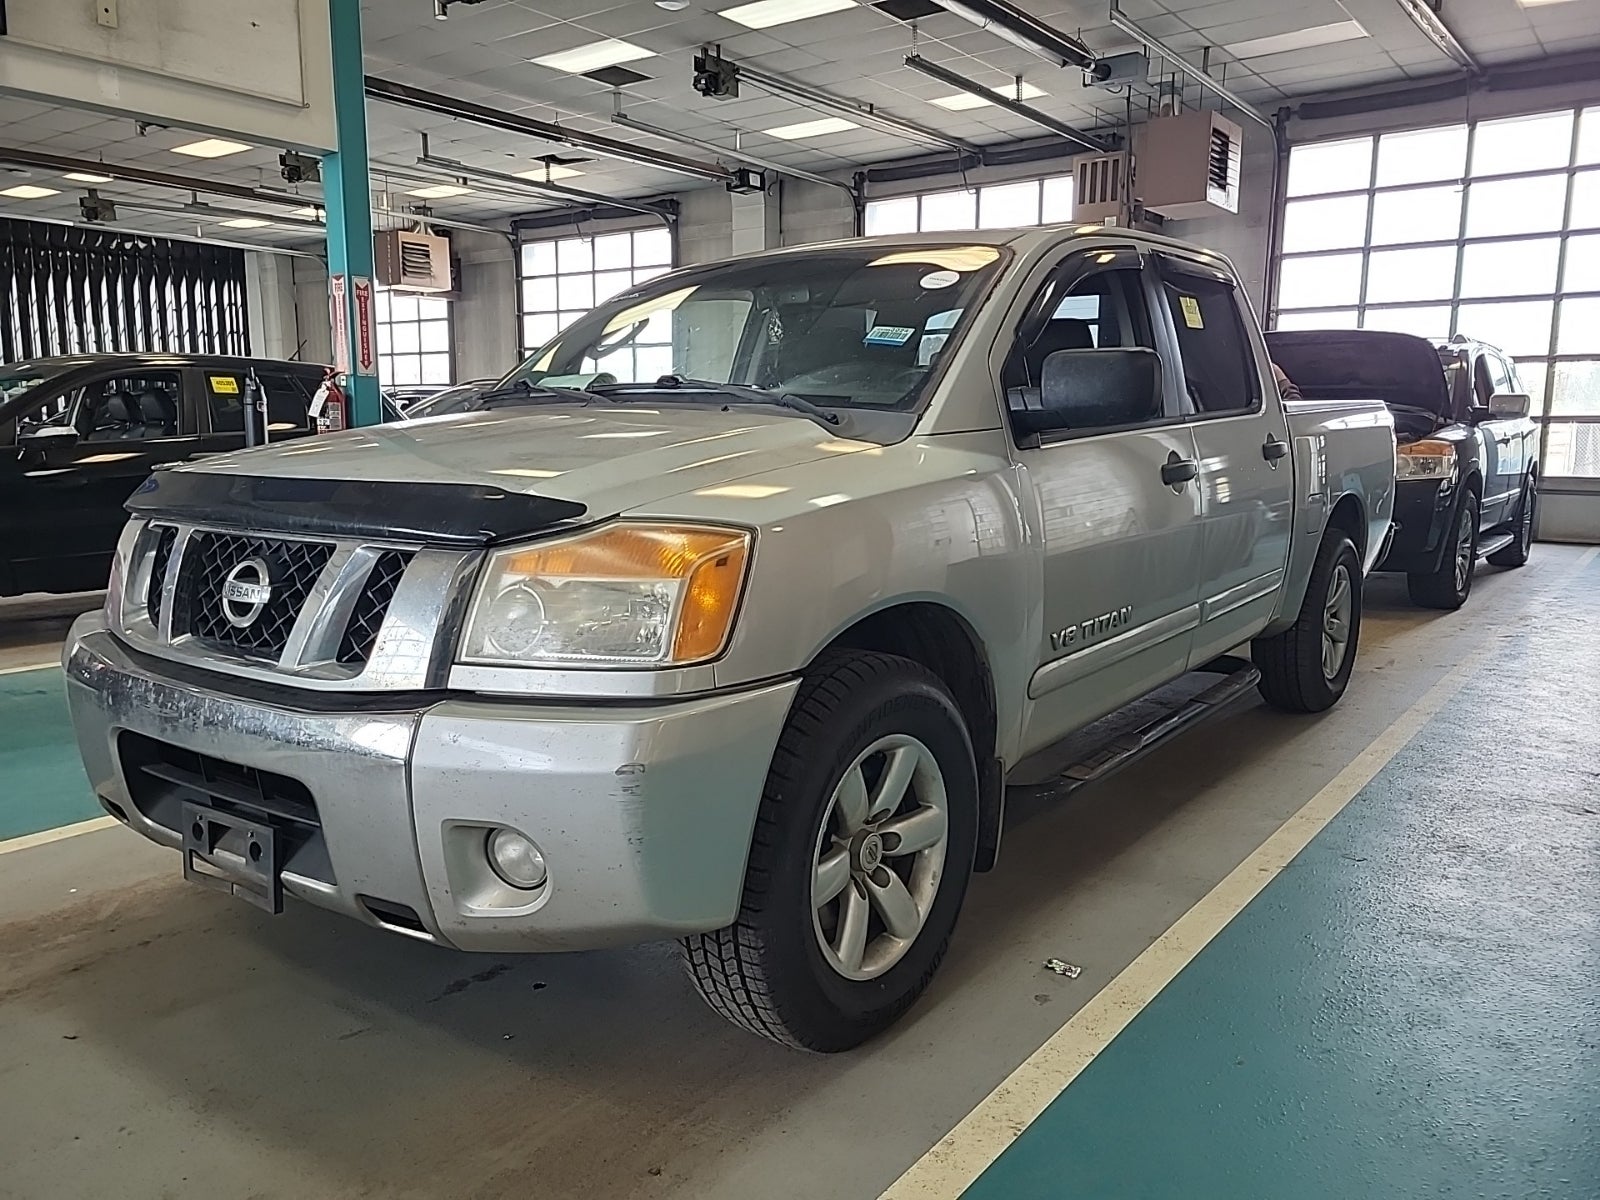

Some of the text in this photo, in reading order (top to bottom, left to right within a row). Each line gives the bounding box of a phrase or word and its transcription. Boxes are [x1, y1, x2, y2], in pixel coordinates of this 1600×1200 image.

[357, 289, 369, 297] FIRE
[360, 296, 370, 366] EXTINGUISHER
[224, 582, 261, 600] NISSAN
[1050, 604, 1133, 651] V8 TITAN
